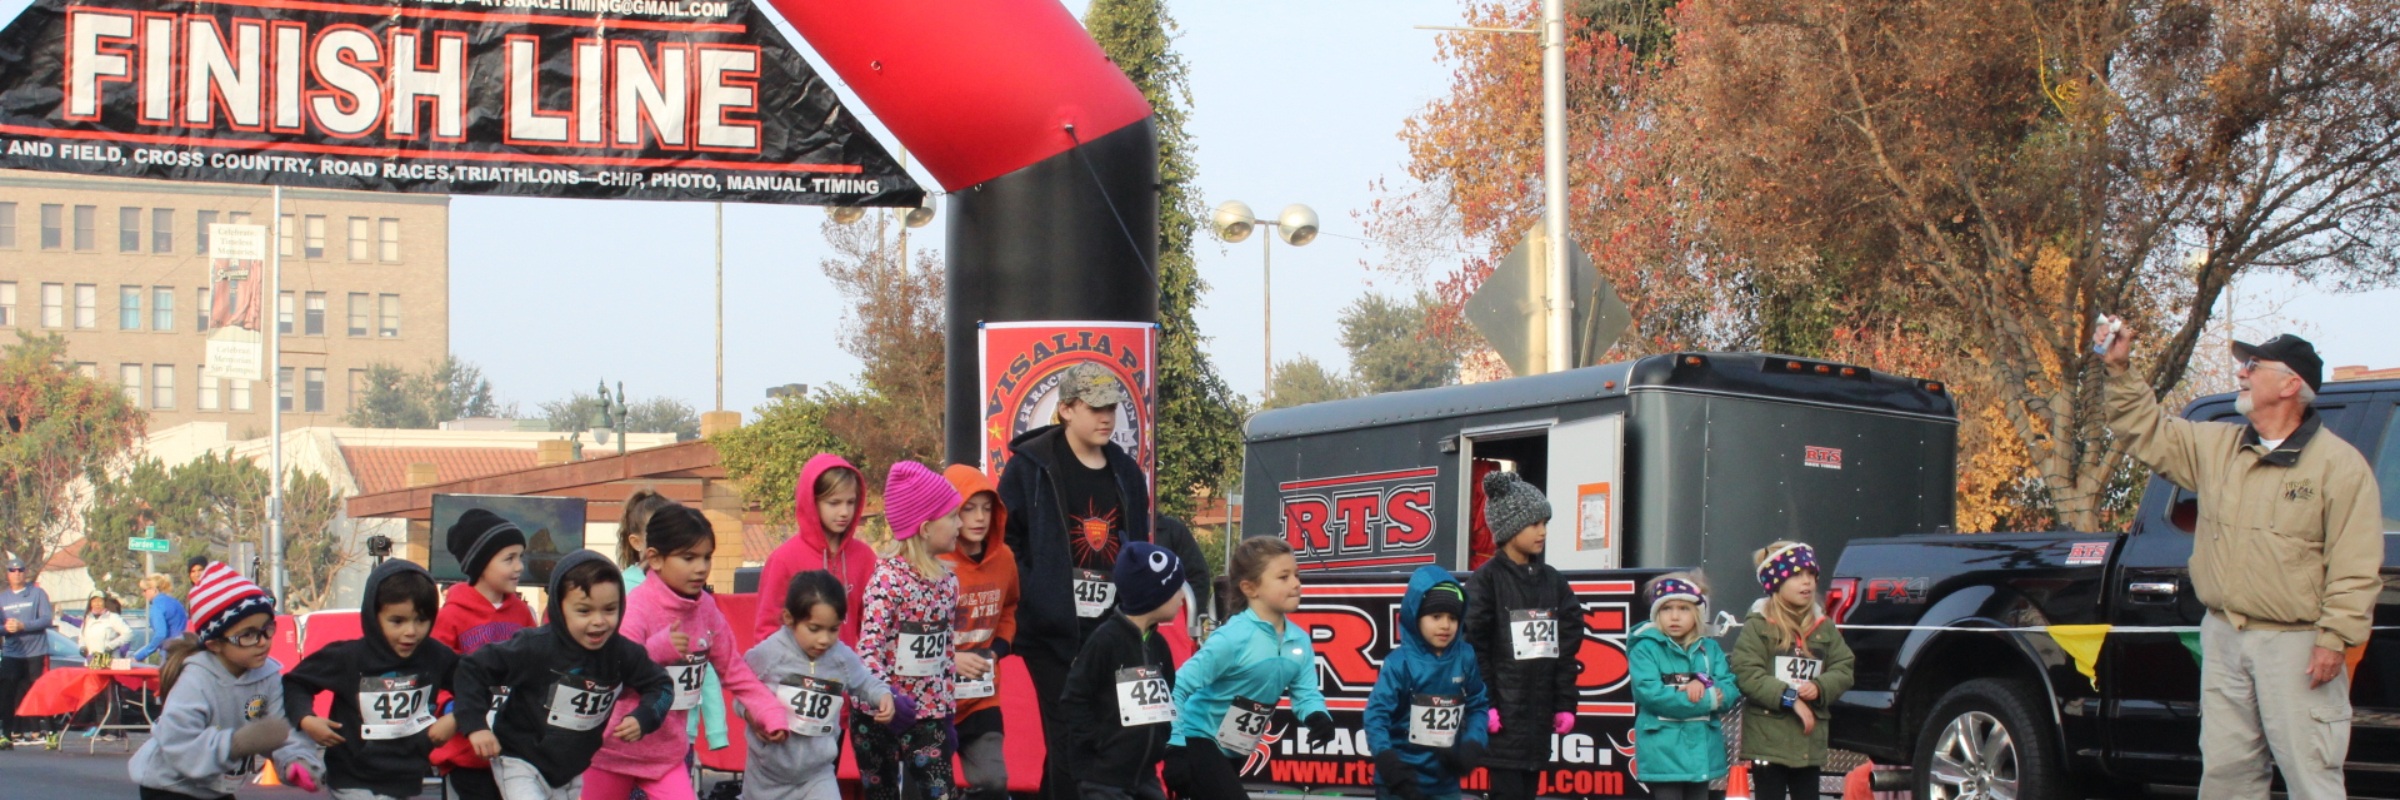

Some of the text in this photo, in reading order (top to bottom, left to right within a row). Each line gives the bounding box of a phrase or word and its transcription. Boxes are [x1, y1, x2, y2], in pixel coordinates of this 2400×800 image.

[64, 6, 762, 153] FINISH LINE
[8, 140, 53, 158] AND
[60, 144, 127, 166] FIELD,
[134, 148, 205, 167] CROSS
[211, 153, 313, 177] COUNTRY,
[320, 159, 377, 177] ROAD
[651, 173, 722, 192] PHOTO,
[727, 175, 806, 193] MANUAL
[812, 178, 880, 195] TIMING
[986, 332, 1113, 420] VISALIA
[1805, 449, 1841, 462] RTS
[1280, 484, 1436, 557] RTS
[2069, 546, 2107, 557] RTS
[1074, 581, 1108, 603] 415
[1866, 577, 1929, 602] FX4
[1523, 620, 1555, 643] 424
[909, 634, 945, 660] 429
[1786, 658, 1817, 681] 427
[373, 690, 423, 720] 420
[570, 691, 615, 716] 419
[790, 690, 832, 719] 418
[1130, 680, 1170, 706] 425
[1421, 707, 1460, 731] 423
